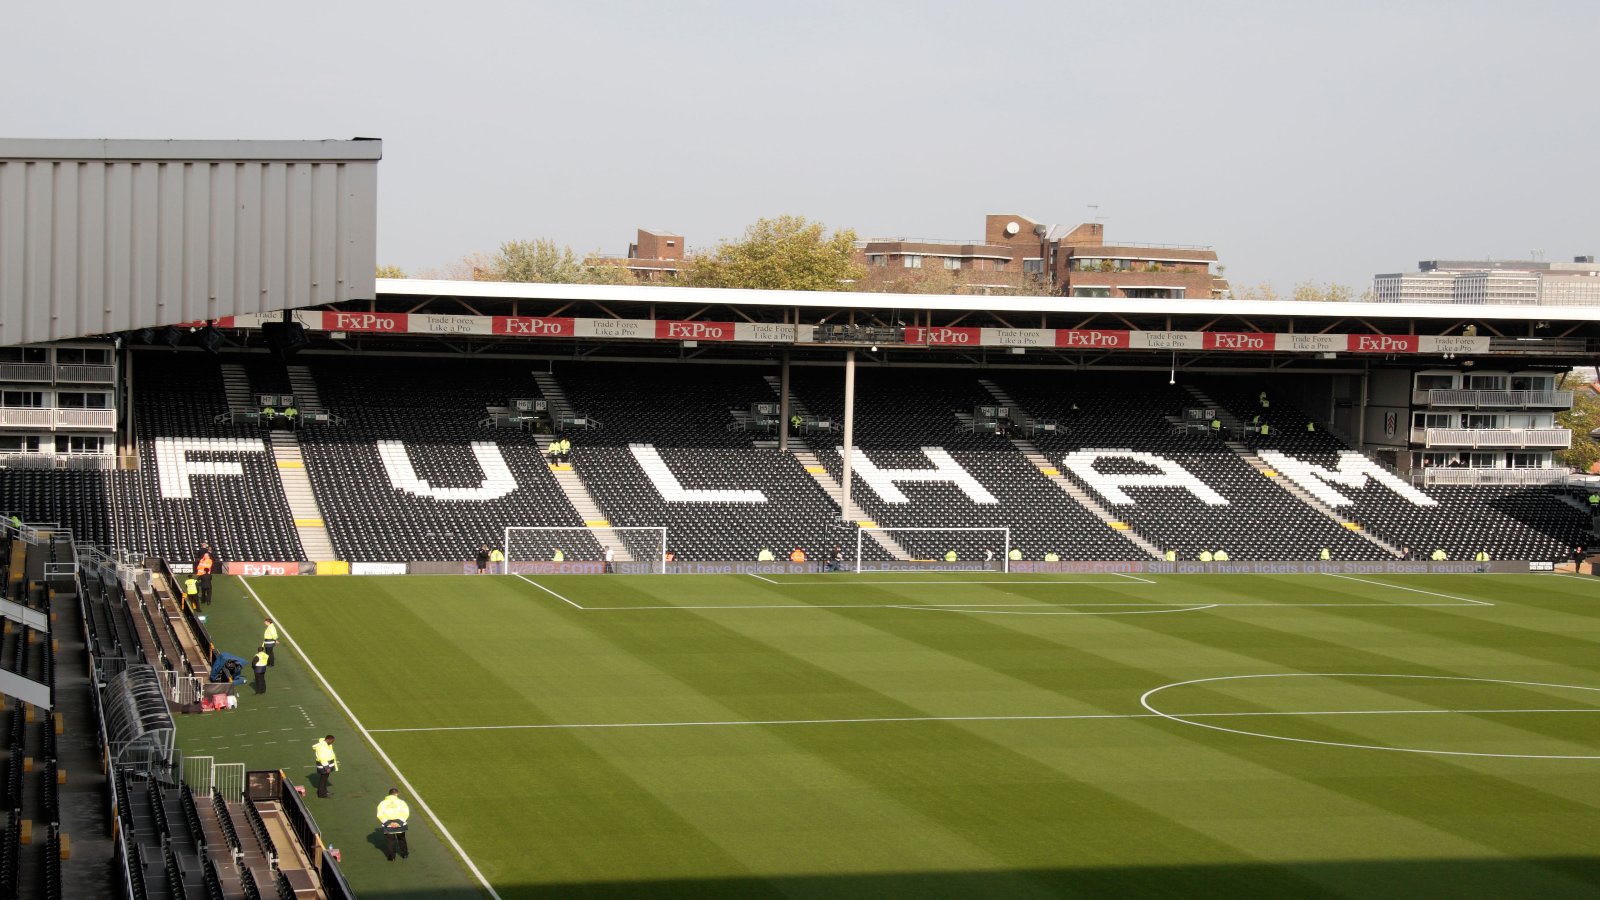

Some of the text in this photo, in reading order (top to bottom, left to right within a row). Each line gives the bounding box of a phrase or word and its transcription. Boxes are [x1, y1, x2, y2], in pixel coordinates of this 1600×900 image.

[336, 313, 395, 329] FxPro
[427, 316, 474, 325] Trade Forex
[505, 318, 562, 334] FxPro
[593, 320, 639, 329] Trade Forex
[595, 328, 612, 336] Like
[668, 322, 723, 338] FxPro
[917, 328, 969, 343] FxPro
[1067, 331, 1118, 345] FxPro
[1214, 334, 1264, 348] FxPro
[1358, 336, 1408, 350] FxPro
[243, 564, 285, 575] FxPro
[696, 563, 732, 573] have
[736, 563, 784, 573] tickets
[790, 563, 803, 573] to
[1149, 562, 1173, 573] Still
[1180, 562, 1213, 573] don't
[1217, 562, 1249, 573] have
[1254, 562, 1298, 573] tickets
[1303, 562, 1316, 573] to
[1320, 561, 1341, 573] the
[1344, 562, 1383, 573] Stone
[1387, 562, 1428, 573] Roses
